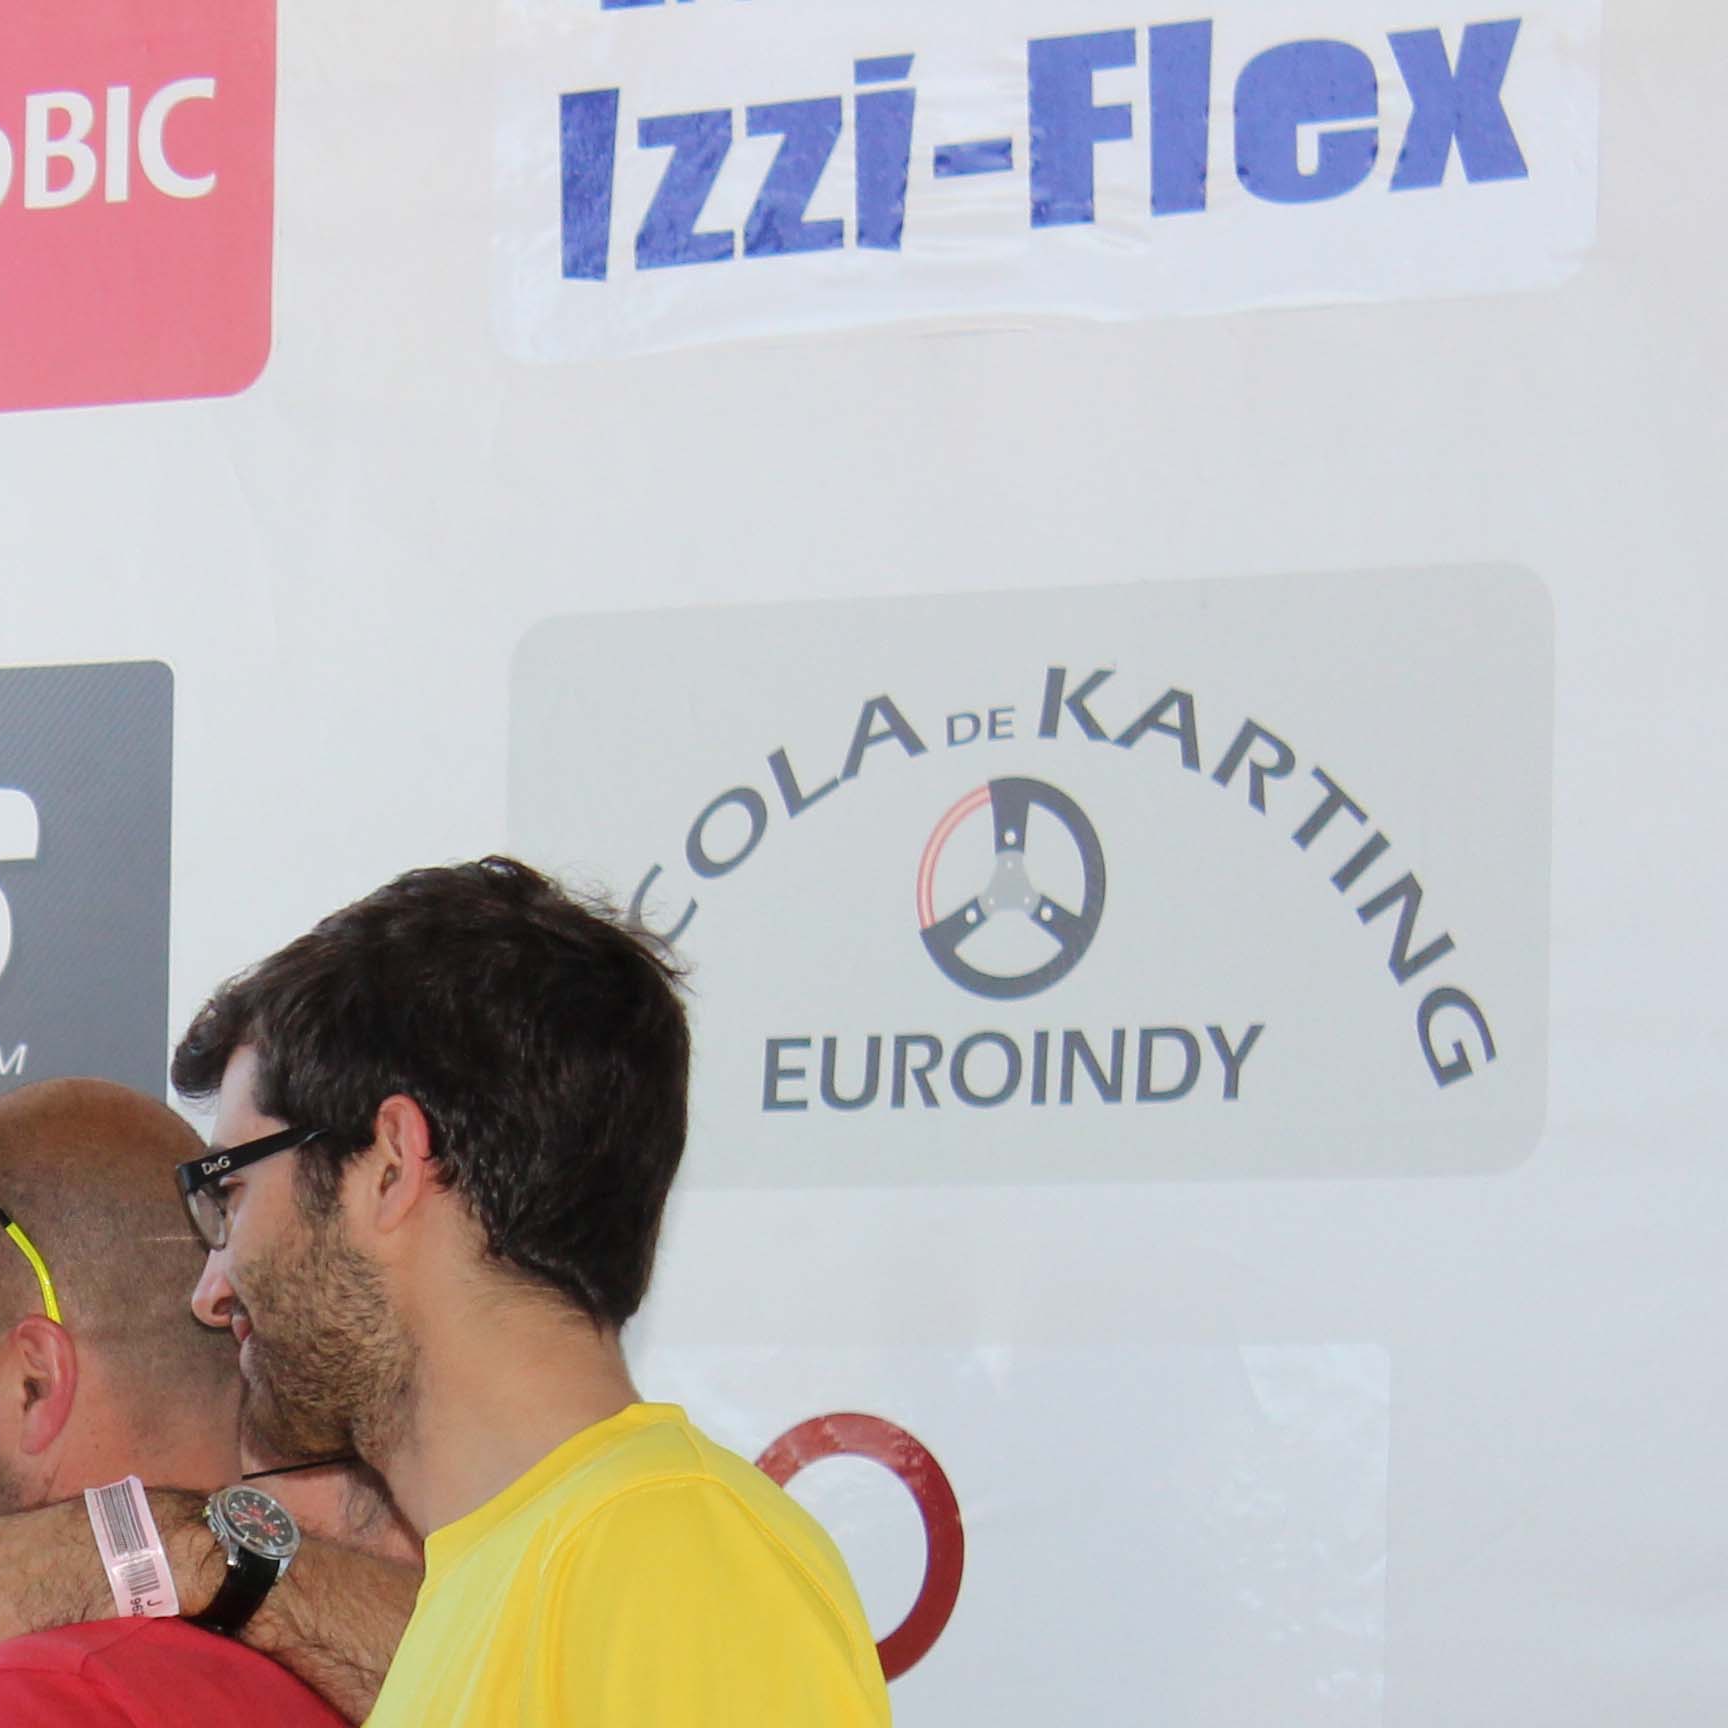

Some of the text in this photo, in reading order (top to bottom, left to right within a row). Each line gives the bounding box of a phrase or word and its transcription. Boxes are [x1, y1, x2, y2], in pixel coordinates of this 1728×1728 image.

[558, 17, 1529, 282] Izzi-Flex
[945, 706, 1016, 748] DE
[1037, 665, 1498, 1090] KARTING
[761, 1022, 1266, 1113] EUROINDY
